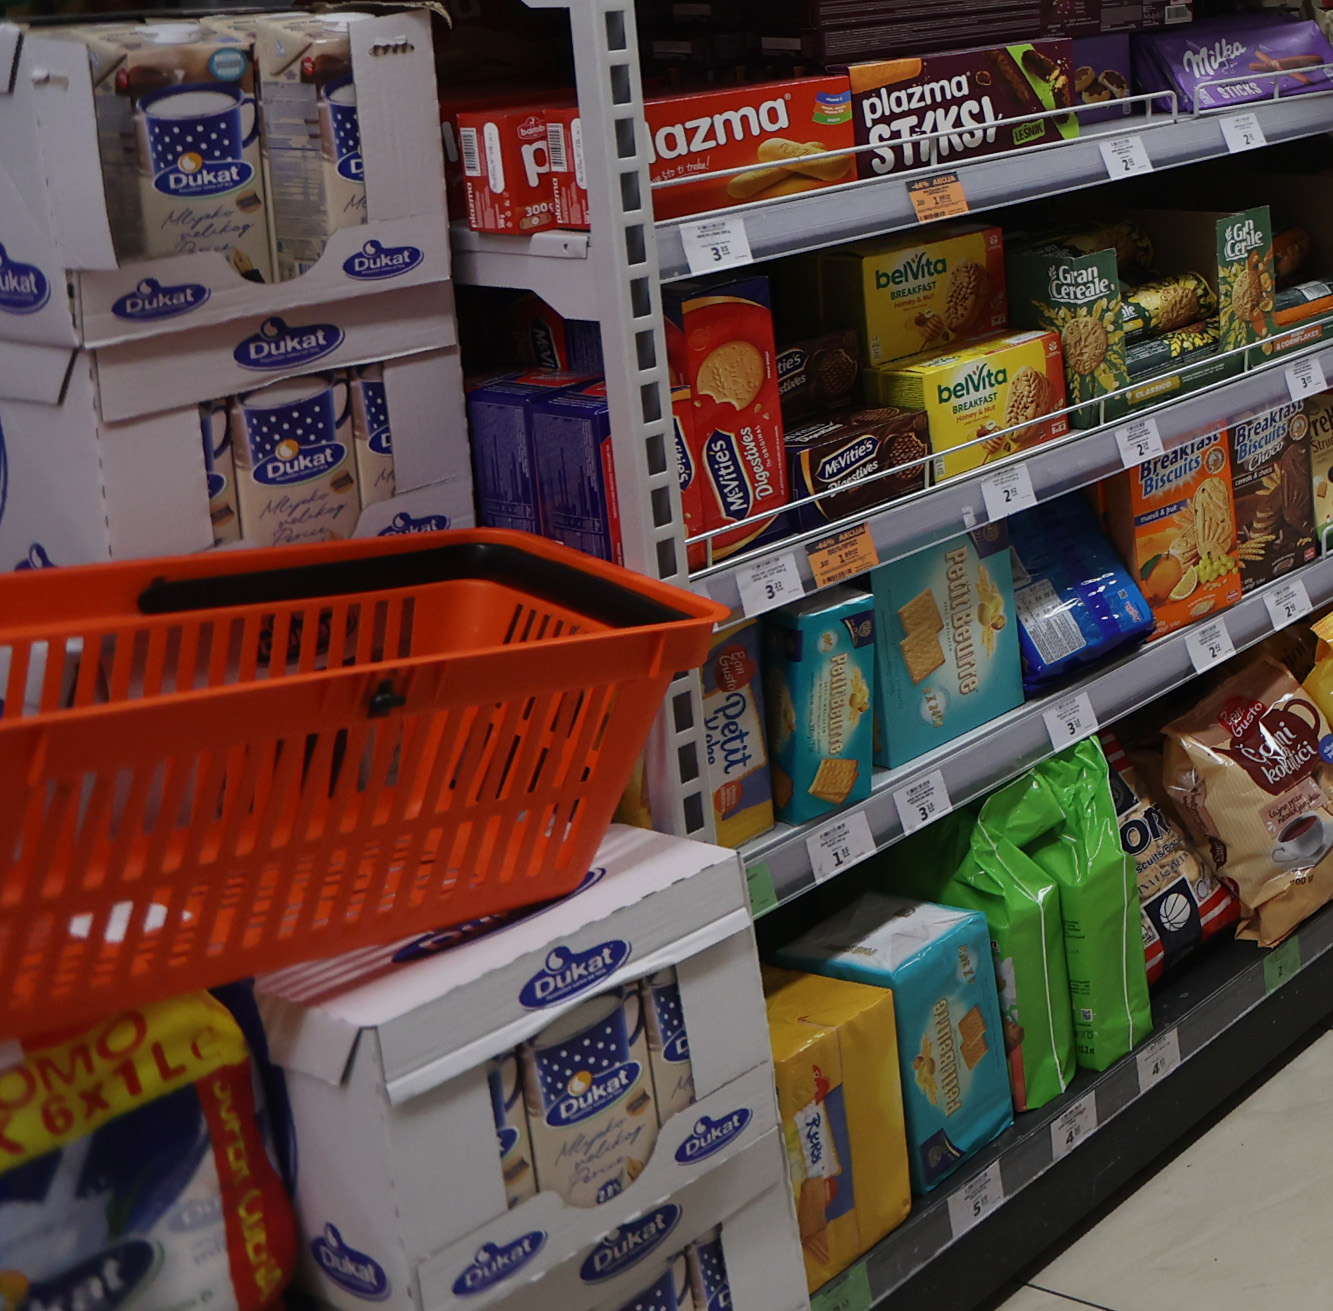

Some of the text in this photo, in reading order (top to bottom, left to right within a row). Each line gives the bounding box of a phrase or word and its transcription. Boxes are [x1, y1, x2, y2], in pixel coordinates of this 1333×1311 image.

[1183, 38, 1247, 79] Milka
[861, 73, 970, 129] plazma
[1216, 82, 1263, 100] STICKS
[647, 98, 790, 163] lazma
[1013, 120, 1045, 143] LEŠNIK
[168, 165, 240, 190] Dukat
[466, 181, 477, 229] plazma
[553, 177, 563, 224] plazma
[353, 249, 411, 272] Dukat
[712, 246, 722, 262] 3
[874, 251, 948, 290] belVita
[0, 269, 39, 296] ukat
[889, 281, 937, 302] BREAKFAST
[1050, 276, 1110, 303] Cereale
[1056, 264, 1099, 286] Gran
[125, 286, 195, 313] Dukat
[893, 292, 937, 310] Honey Nut
[248, 327, 326, 361] Dukat
[936, 362, 1009, 405] belVita
[1134, 380, 1173, 400] CLASSICO
[951, 391, 998, 416] BREAKFAST
[956, 404, 997, 424] Honey Nut
[823, 438, 874, 481] McVitie's
[1238, 422, 1288, 462] Biscuits
[1248, 441, 1285, 471] Choco
[266, 447, 334, 479] Dukat
[720, 438, 749, 513] McVitie's
[739, 426, 774, 501] Digestives
[827, 459, 879, 498] Digestives
[1142, 455, 1202, 499] Biscuits
[766, 583, 775, 599] 3
[944, 544, 967, 604] Petit
[948, 608, 978, 697] Beurre
[714, 692, 751, 775] Petit
[1066, 722, 1074, 735] 3
[1231, 700, 1264, 737] Gusto
[920, 805, 928, 822] 3
[534, 946, 615, 1000] Dukat
[558, 1069, 630, 1122] Dukat
[684, 1116, 741, 1155] Dukat
[603, 1214, 668, 1267] Dukat
[320, 1247, 377, 1286] Dukat
[461, 1238, 534, 1290] Dukat
